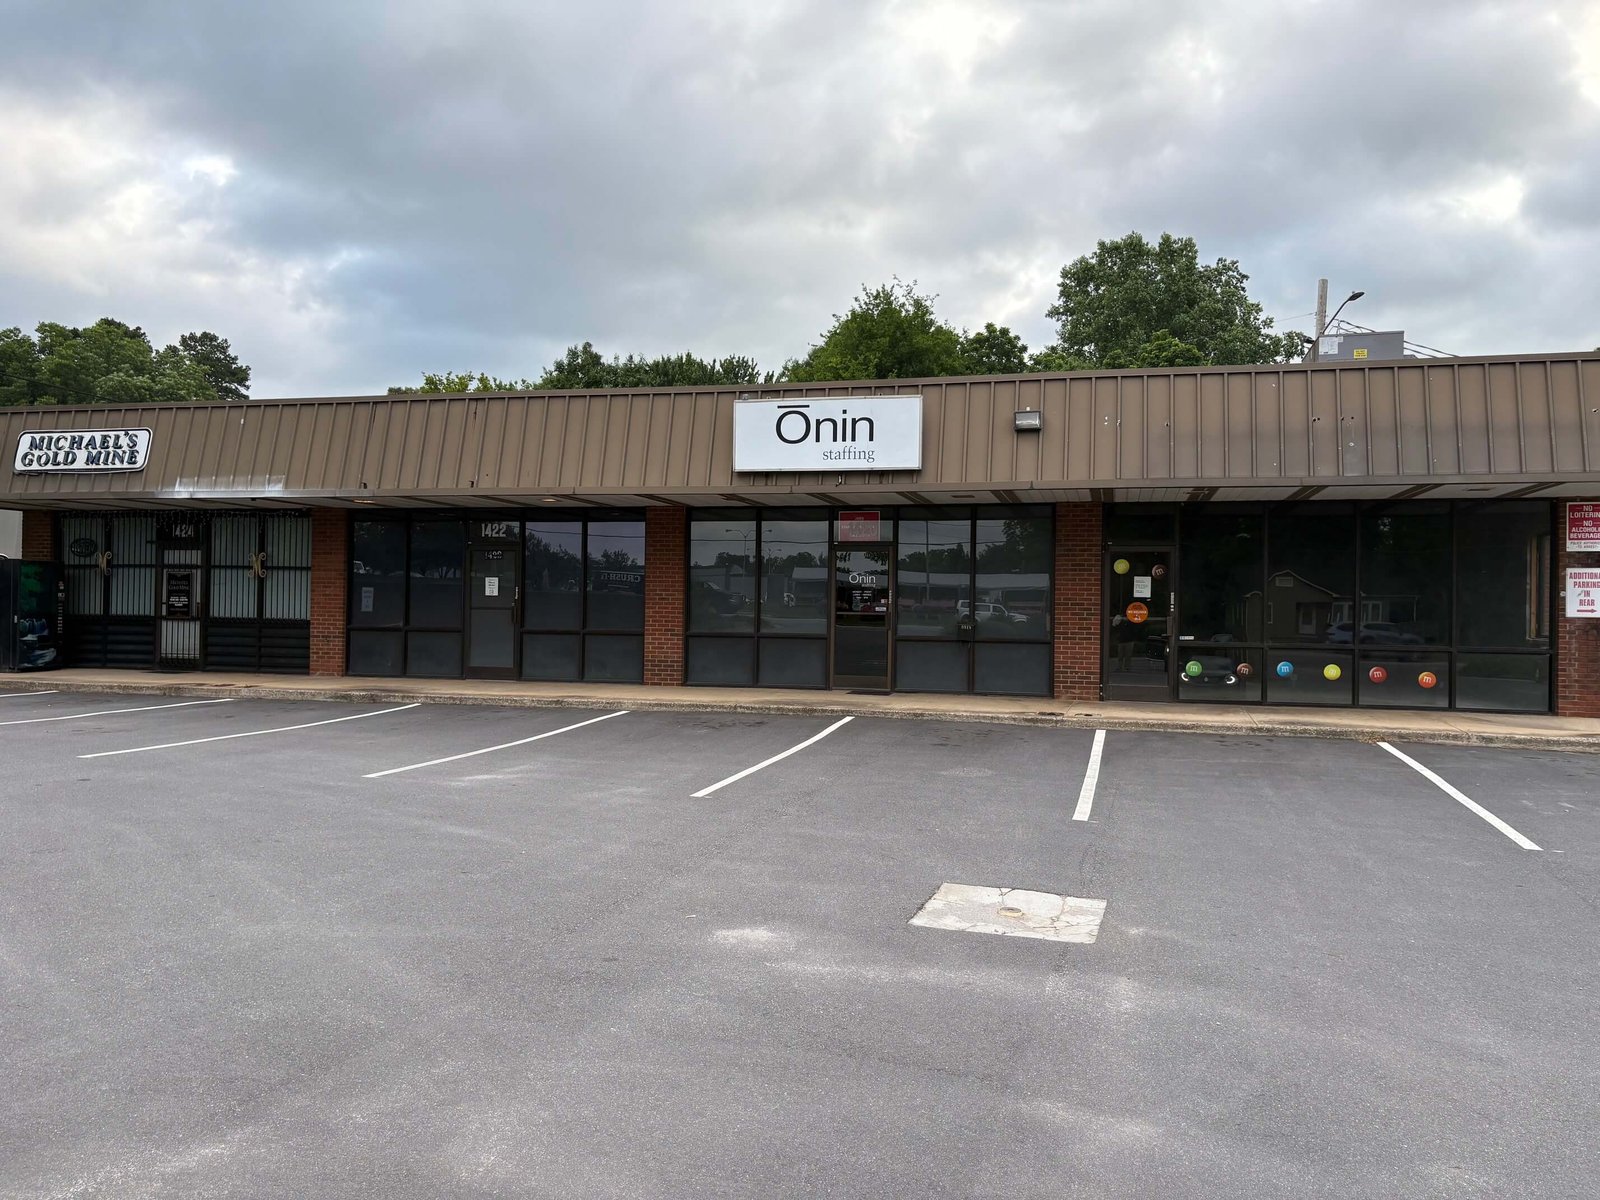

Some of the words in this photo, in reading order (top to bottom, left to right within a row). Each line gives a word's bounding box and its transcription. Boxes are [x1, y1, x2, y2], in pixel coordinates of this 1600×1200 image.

[28, 430, 138, 451] MICHAEL'S
[21, 450, 78, 467] GOLD
[84, 450, 140, 466] MINE
[822, 446, 875, 462] staffing
[172, 524, 193, 537] 1424
[482, 524, 506, 537] 1422
